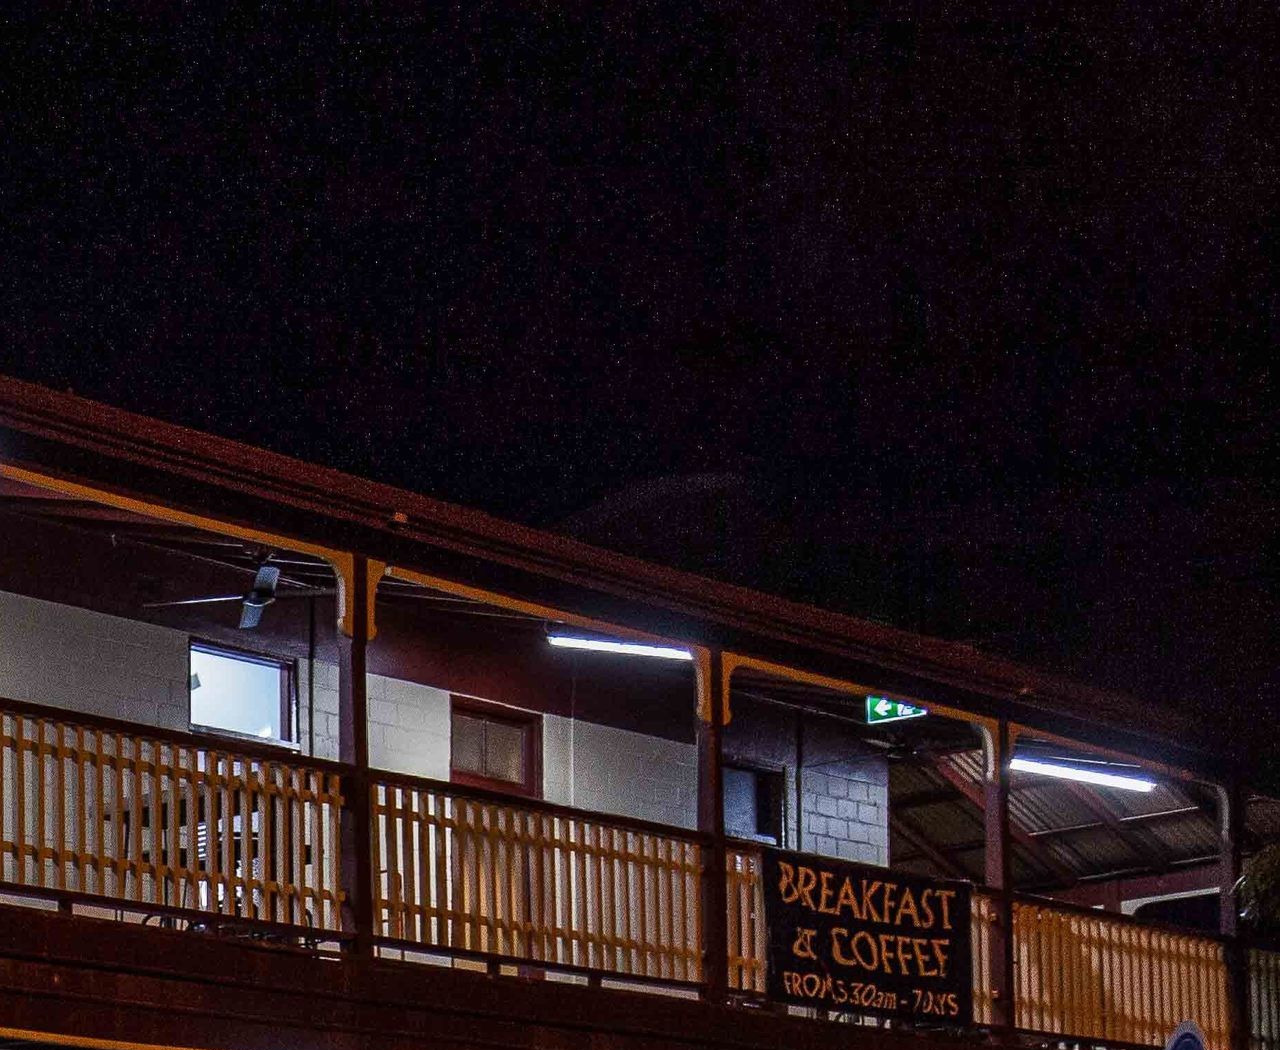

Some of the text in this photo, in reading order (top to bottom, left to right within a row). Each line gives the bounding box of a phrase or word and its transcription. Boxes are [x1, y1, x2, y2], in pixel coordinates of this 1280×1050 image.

[778, 861, 956, 930] BREAKFAST
[792, 927, 950, 978] & COFFEE
[783, 971, 837, 1002] FROM
